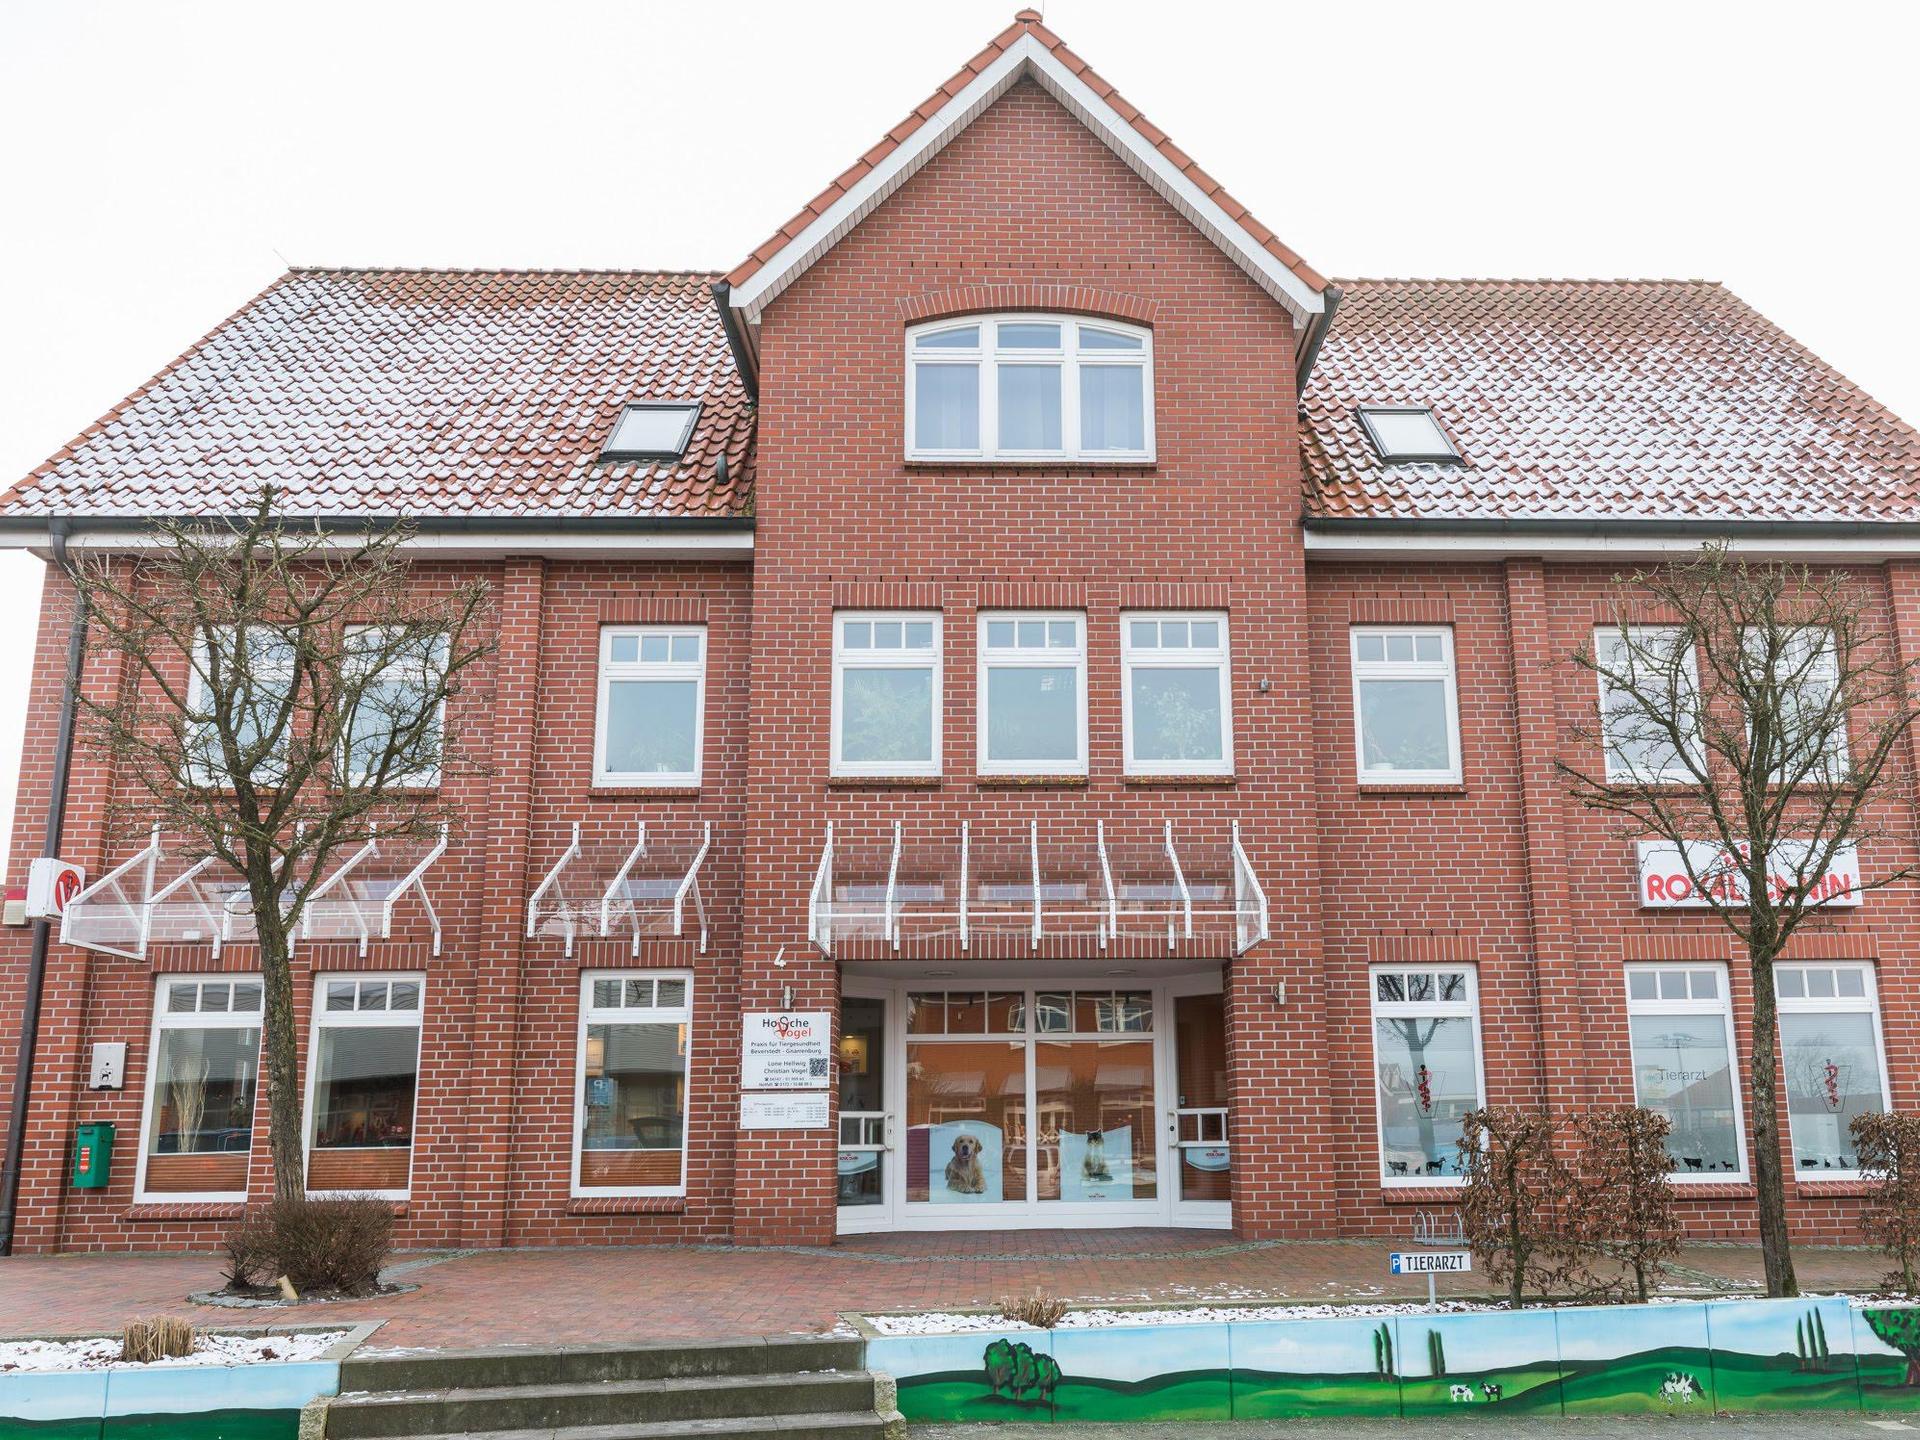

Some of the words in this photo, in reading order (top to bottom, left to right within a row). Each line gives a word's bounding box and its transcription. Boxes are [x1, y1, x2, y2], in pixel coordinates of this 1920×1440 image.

[1646, 873, 1744, 901] ROYAL
[1656, 1068, 1708, 1081] Tierarzt
[1392, 1258, 1400, 1270] P
[1405, 1255, 1464, 1271] TIERARZT
